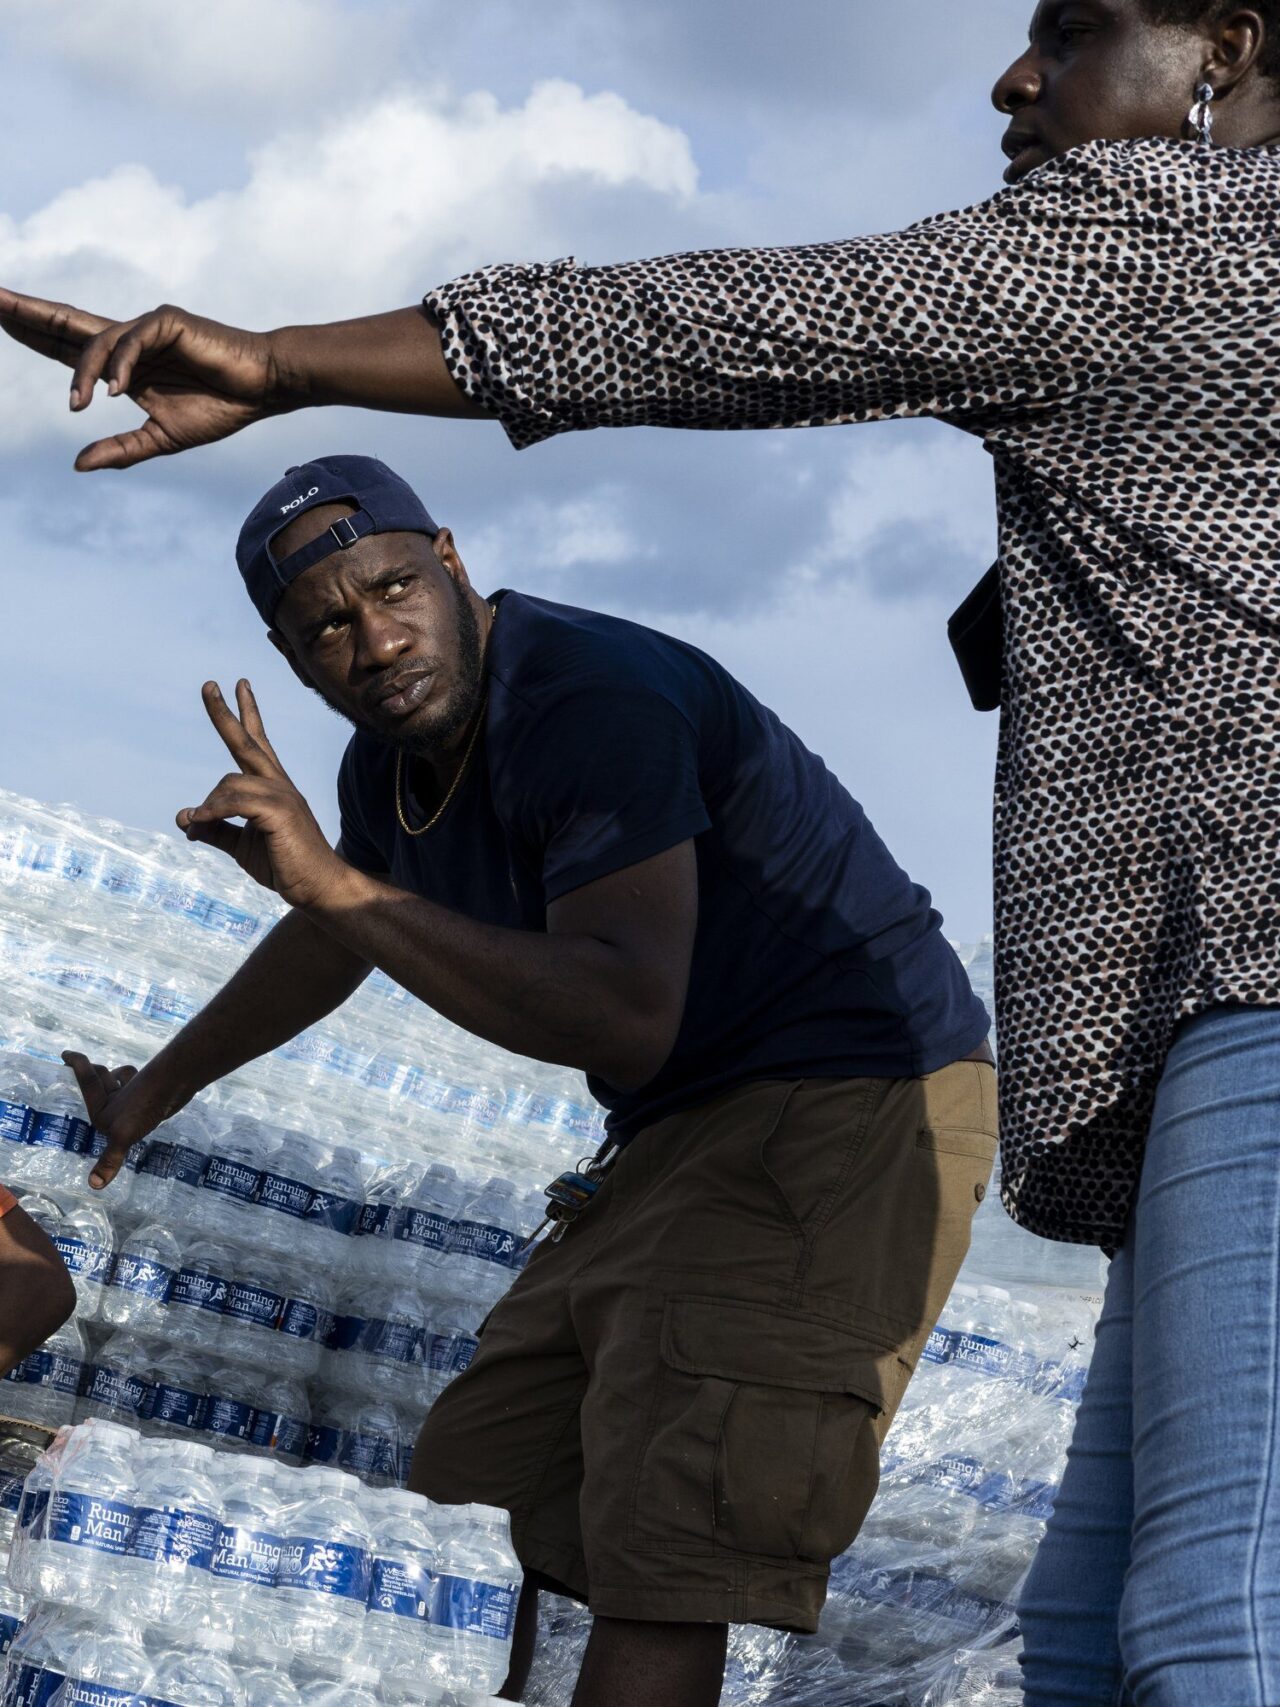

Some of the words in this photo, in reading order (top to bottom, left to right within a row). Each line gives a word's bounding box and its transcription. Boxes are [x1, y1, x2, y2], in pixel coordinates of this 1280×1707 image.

[280, 486, 319, 515] POLO
[207, 1170, 231, 1186] Man
[210, 1159, 256, 1182] Running
[261, 1187, 287, 1204] Man
[265, 1175, 309, 1202] Running
[411, 1224, 438, 1241] Man
[174, 1285, 186, 1295] an
[229, 1285, 275, 1308] Running
[226, 1297, 249, 1312] Man
[956, 1348, 984, 1365] Man
[960, 1336, 1009, 1362] Running
[92, 1381, 118, 1399] Man
[96, 1370, 142, 1396] Running
[84, 1518, 124, 1543] Man
[216, 1549, 248, 1569] Man
